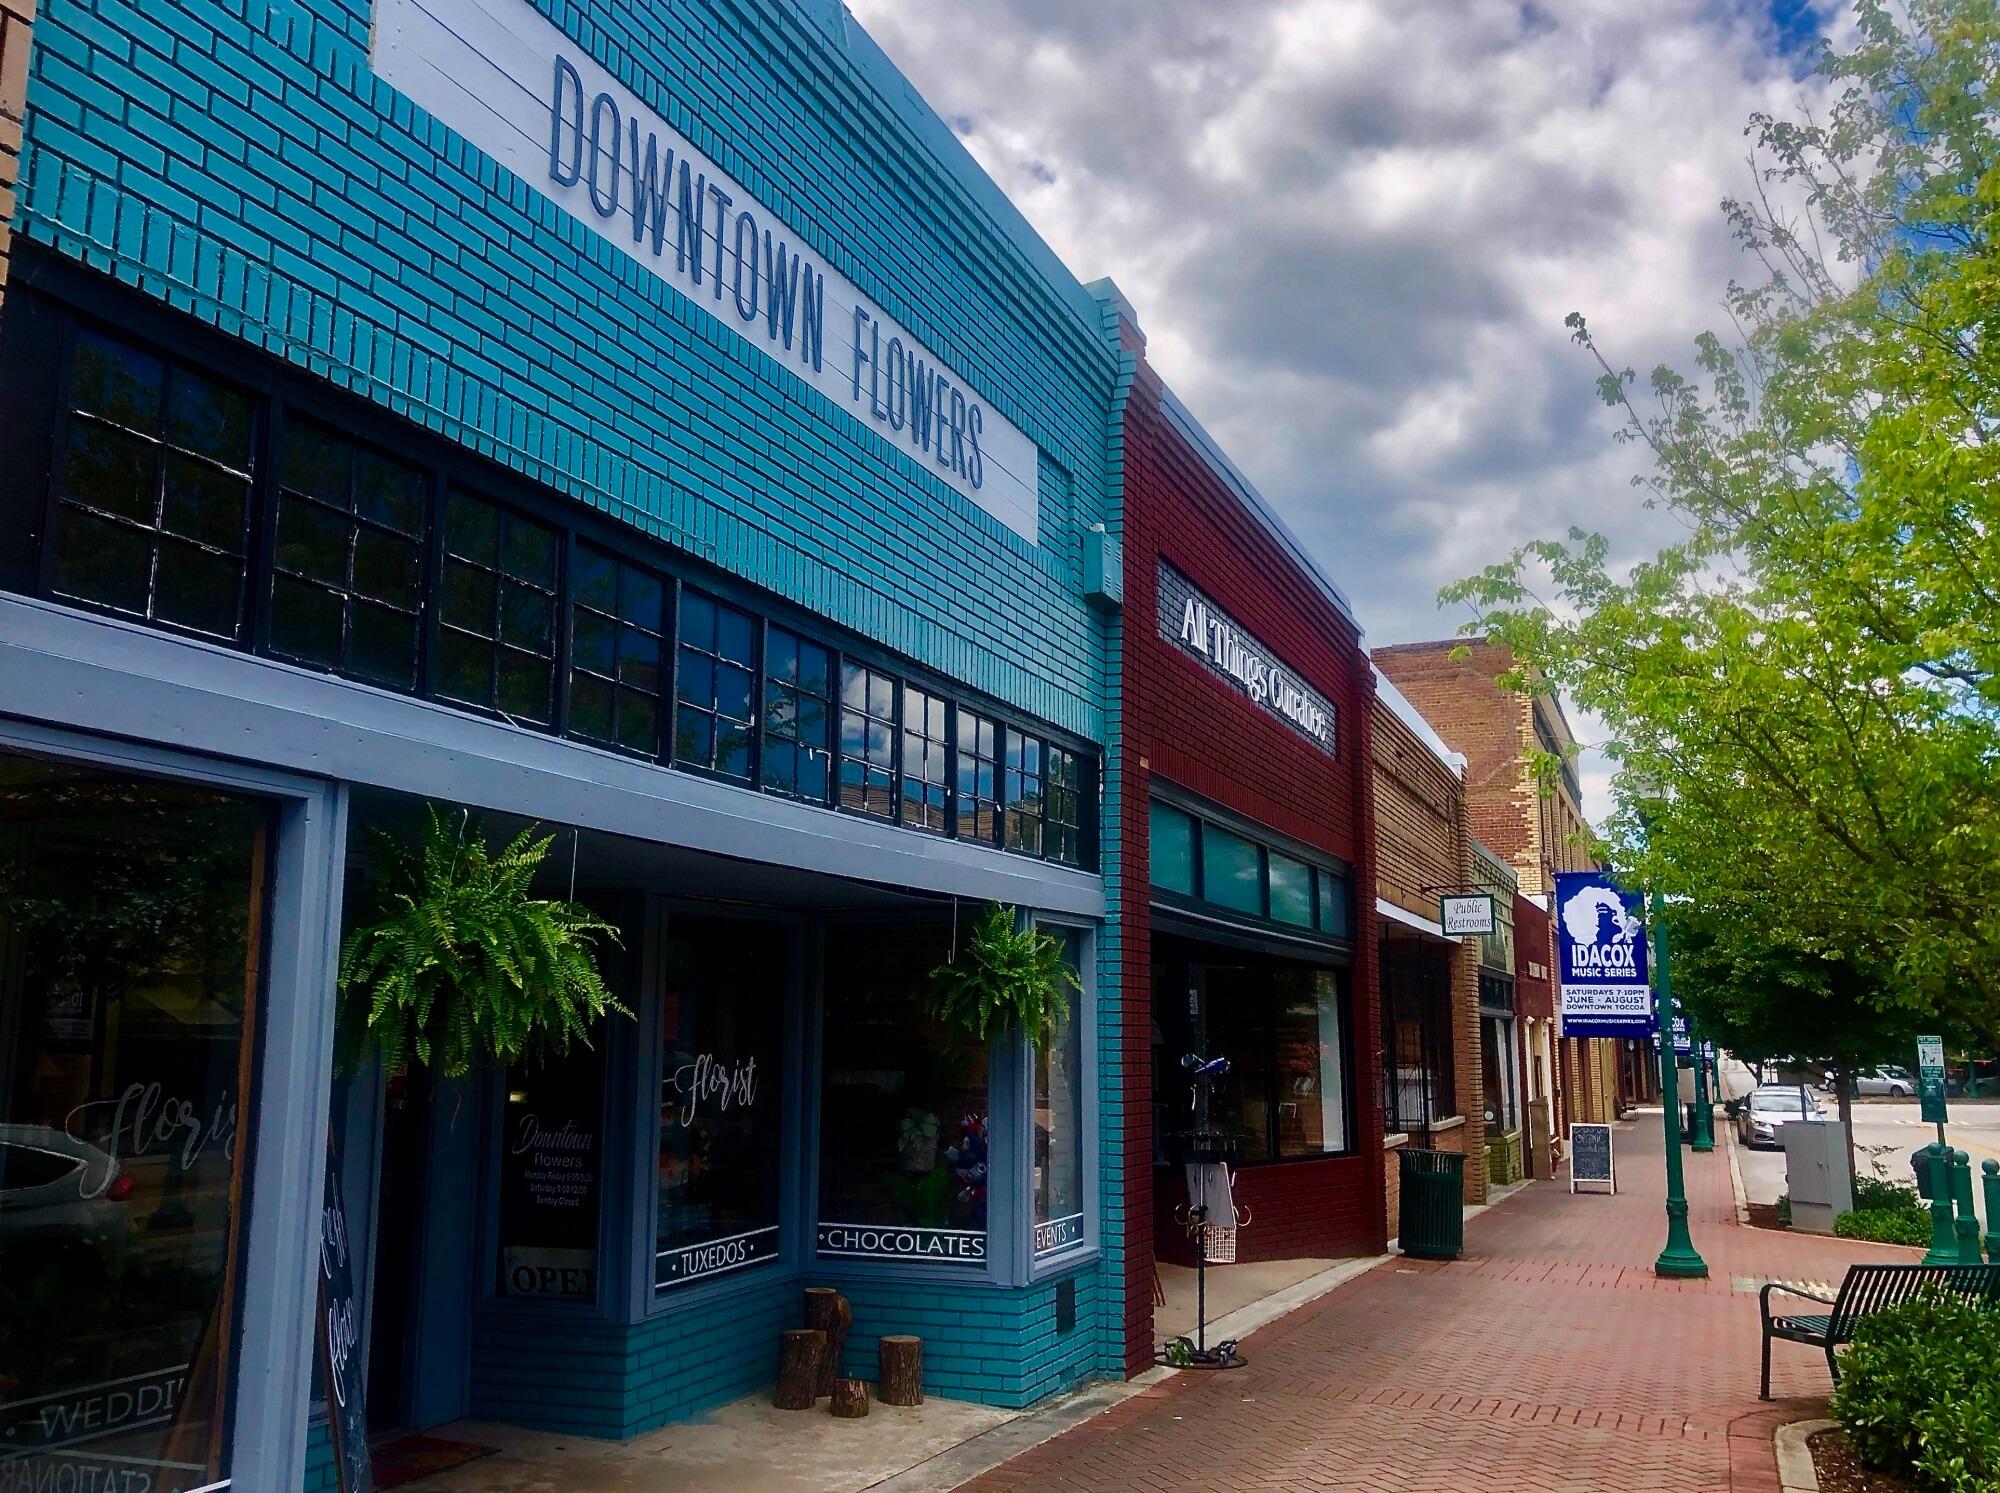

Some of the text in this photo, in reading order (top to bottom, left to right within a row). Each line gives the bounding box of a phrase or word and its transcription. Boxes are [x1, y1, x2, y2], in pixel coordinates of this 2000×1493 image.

[550, 54, 984, 490] DOWNTOWN FLOWERS
[1181, 598, 1326, 742] All Things Currahee
[1454, 899, 1482, 914] Public
[1447, 916, 1491, 930] Restrooms
[1571, 968, 1637, 977] MUSIC SERIES
[1566, 996, 1594, 1004] JUNE
[1604, 996, 1645, 1004] AUGUST
[827, 1230, 985, 1256] CHOCOLATES
[1036, 1222, 1067, 1249] EVENTS
[681, 1240, 746, 1275] TUXEDOS
[40, 1376, 184, 1439] WEDDI
